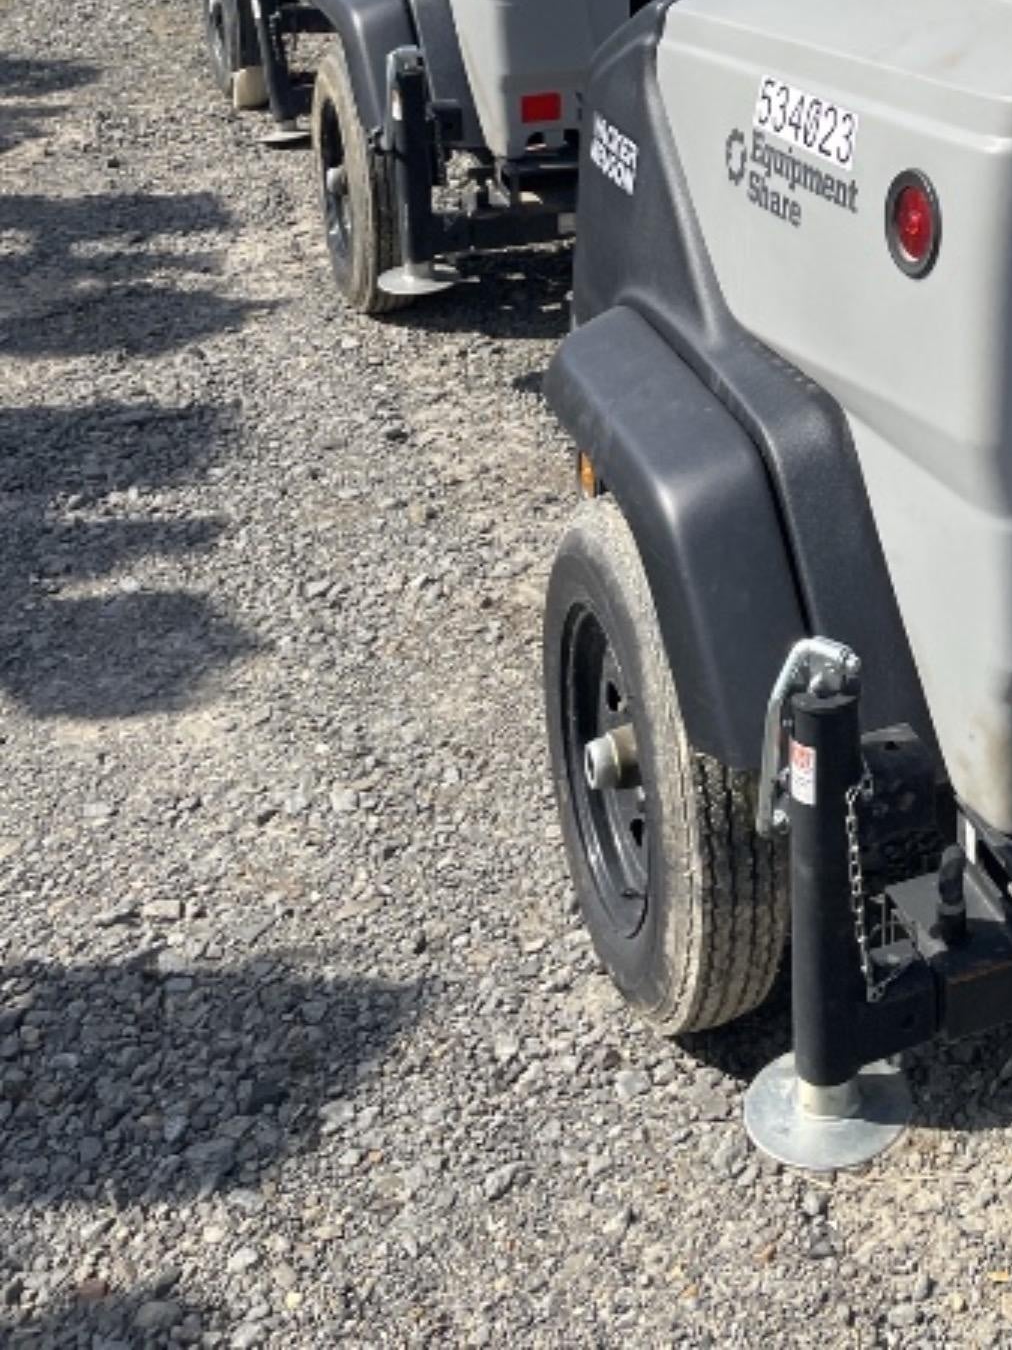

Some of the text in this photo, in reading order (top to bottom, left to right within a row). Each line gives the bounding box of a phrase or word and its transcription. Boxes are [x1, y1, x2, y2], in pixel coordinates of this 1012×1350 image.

[757, 78, 856, 164] 534023
[747, 169, 802, 228] Share
[750, 128, 859, 214] Equipment
